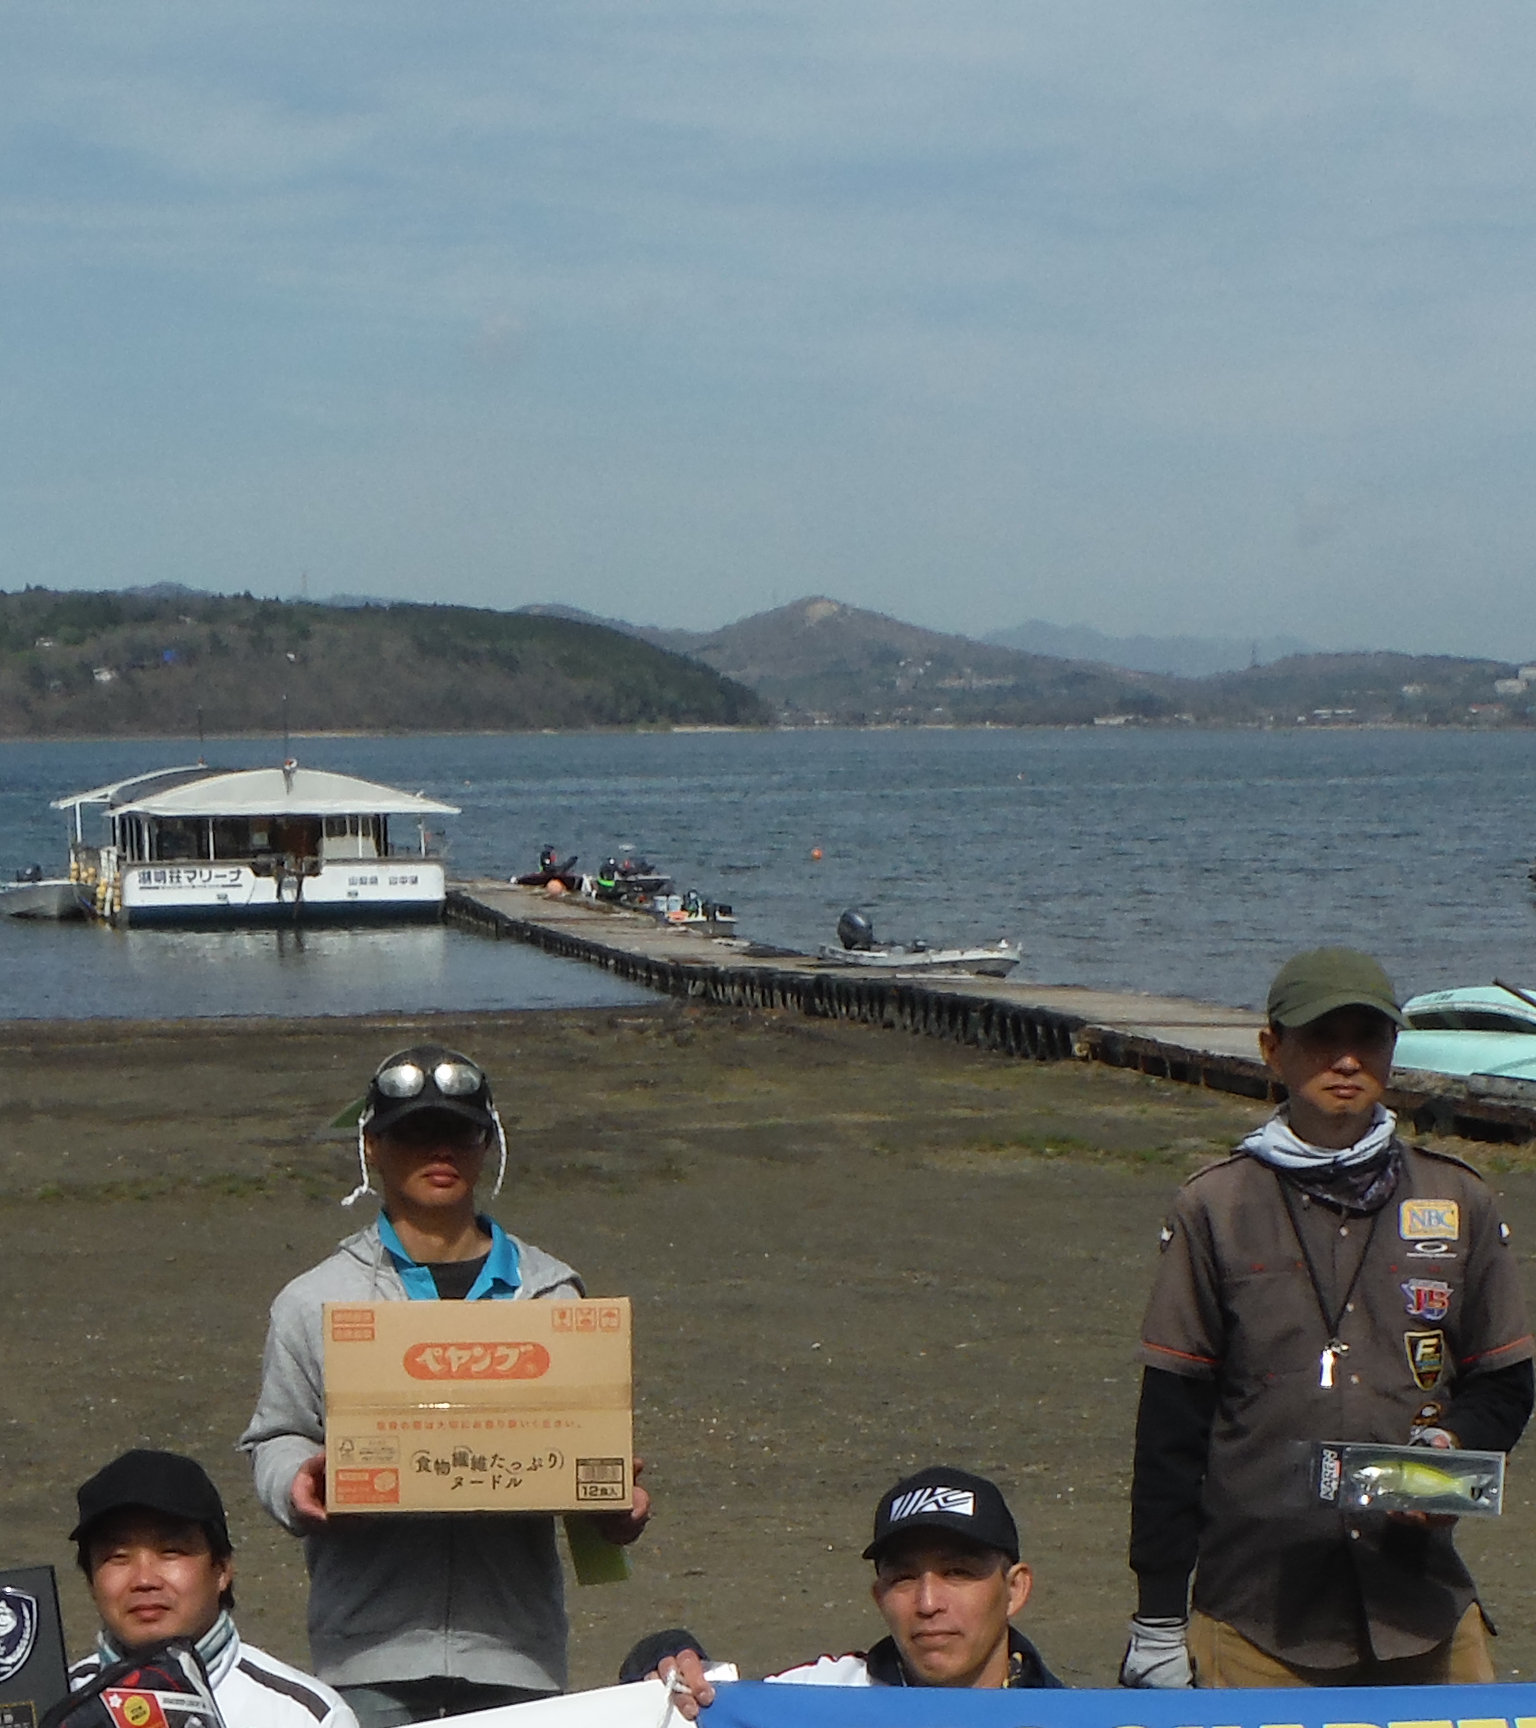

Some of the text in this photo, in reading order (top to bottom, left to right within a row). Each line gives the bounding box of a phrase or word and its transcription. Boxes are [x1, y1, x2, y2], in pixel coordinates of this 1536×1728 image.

[1409, 1209, 1455, 1230] NBC
[415, 1344, 534, 1375] ペヤング
